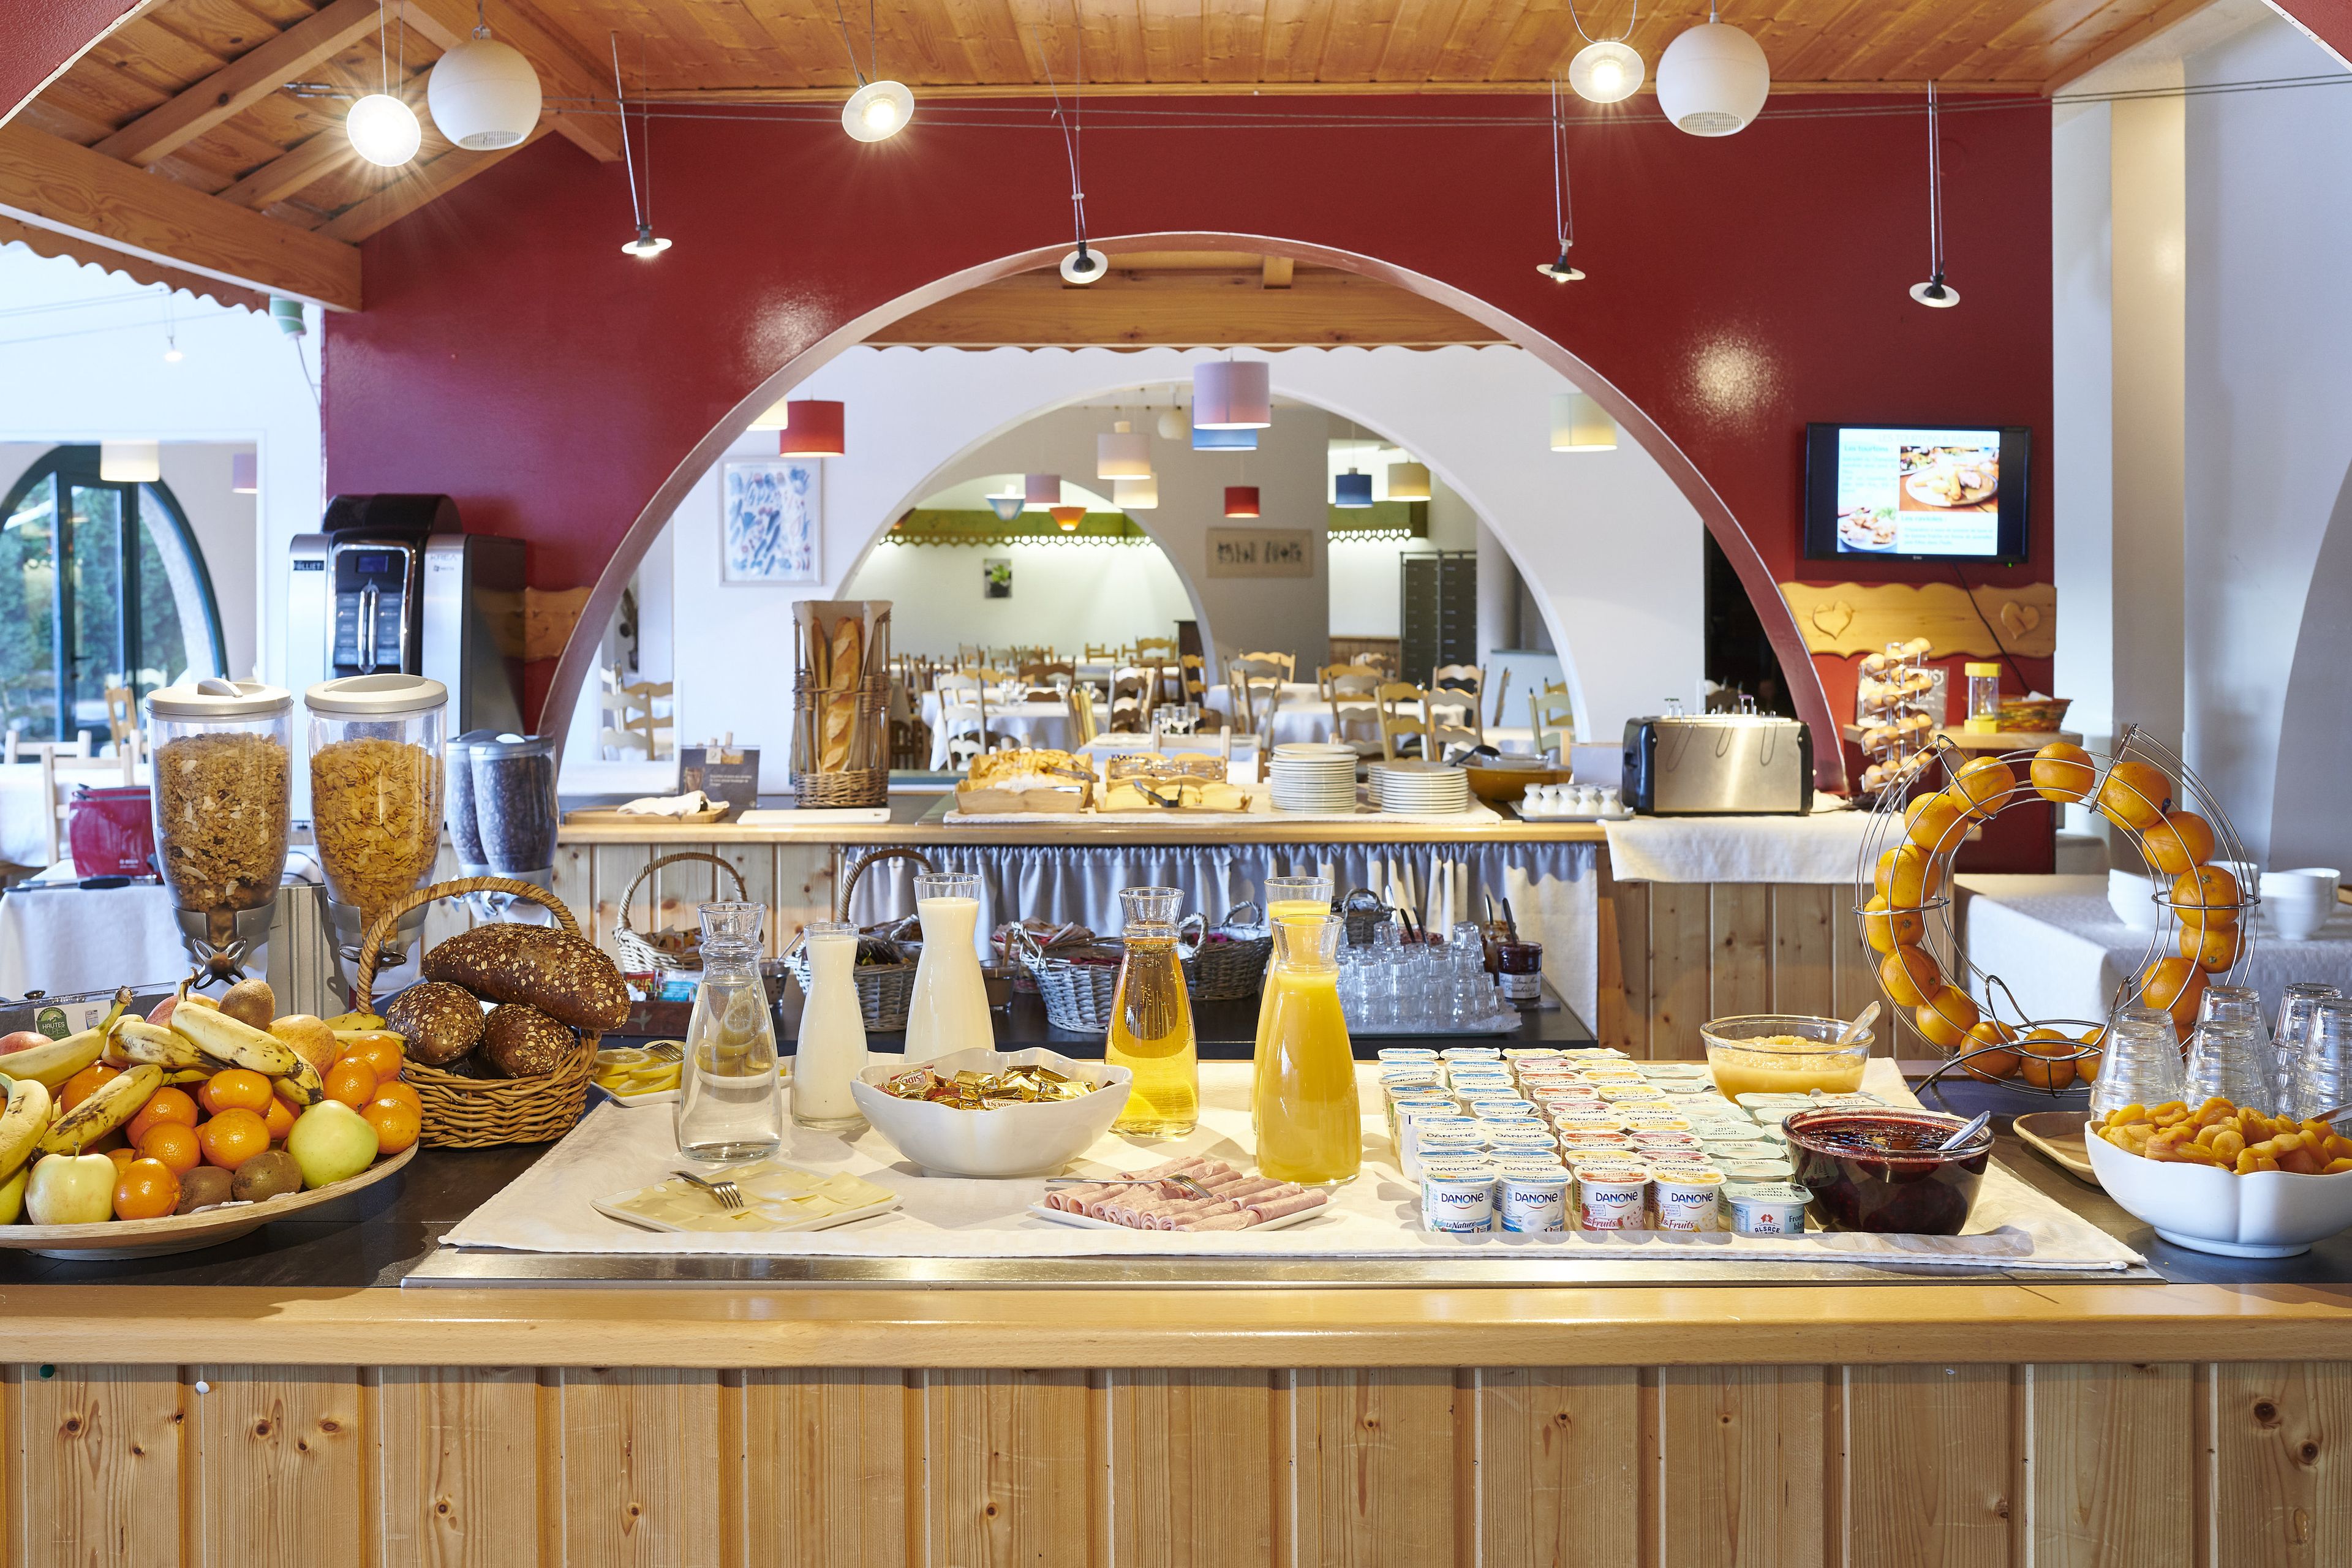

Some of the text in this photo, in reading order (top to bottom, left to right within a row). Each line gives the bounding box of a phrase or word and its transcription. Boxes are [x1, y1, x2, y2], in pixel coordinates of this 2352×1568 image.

[43, 1027, 66, 1035] ALPES
[1441, 1193, 1483, 1204] DANONE
[1515, 1192, 1558, 1204] DANONE
[1596, 1191, 1638, 1202] DANONE
[1671, 1192, 1713, 1204] DANONE
